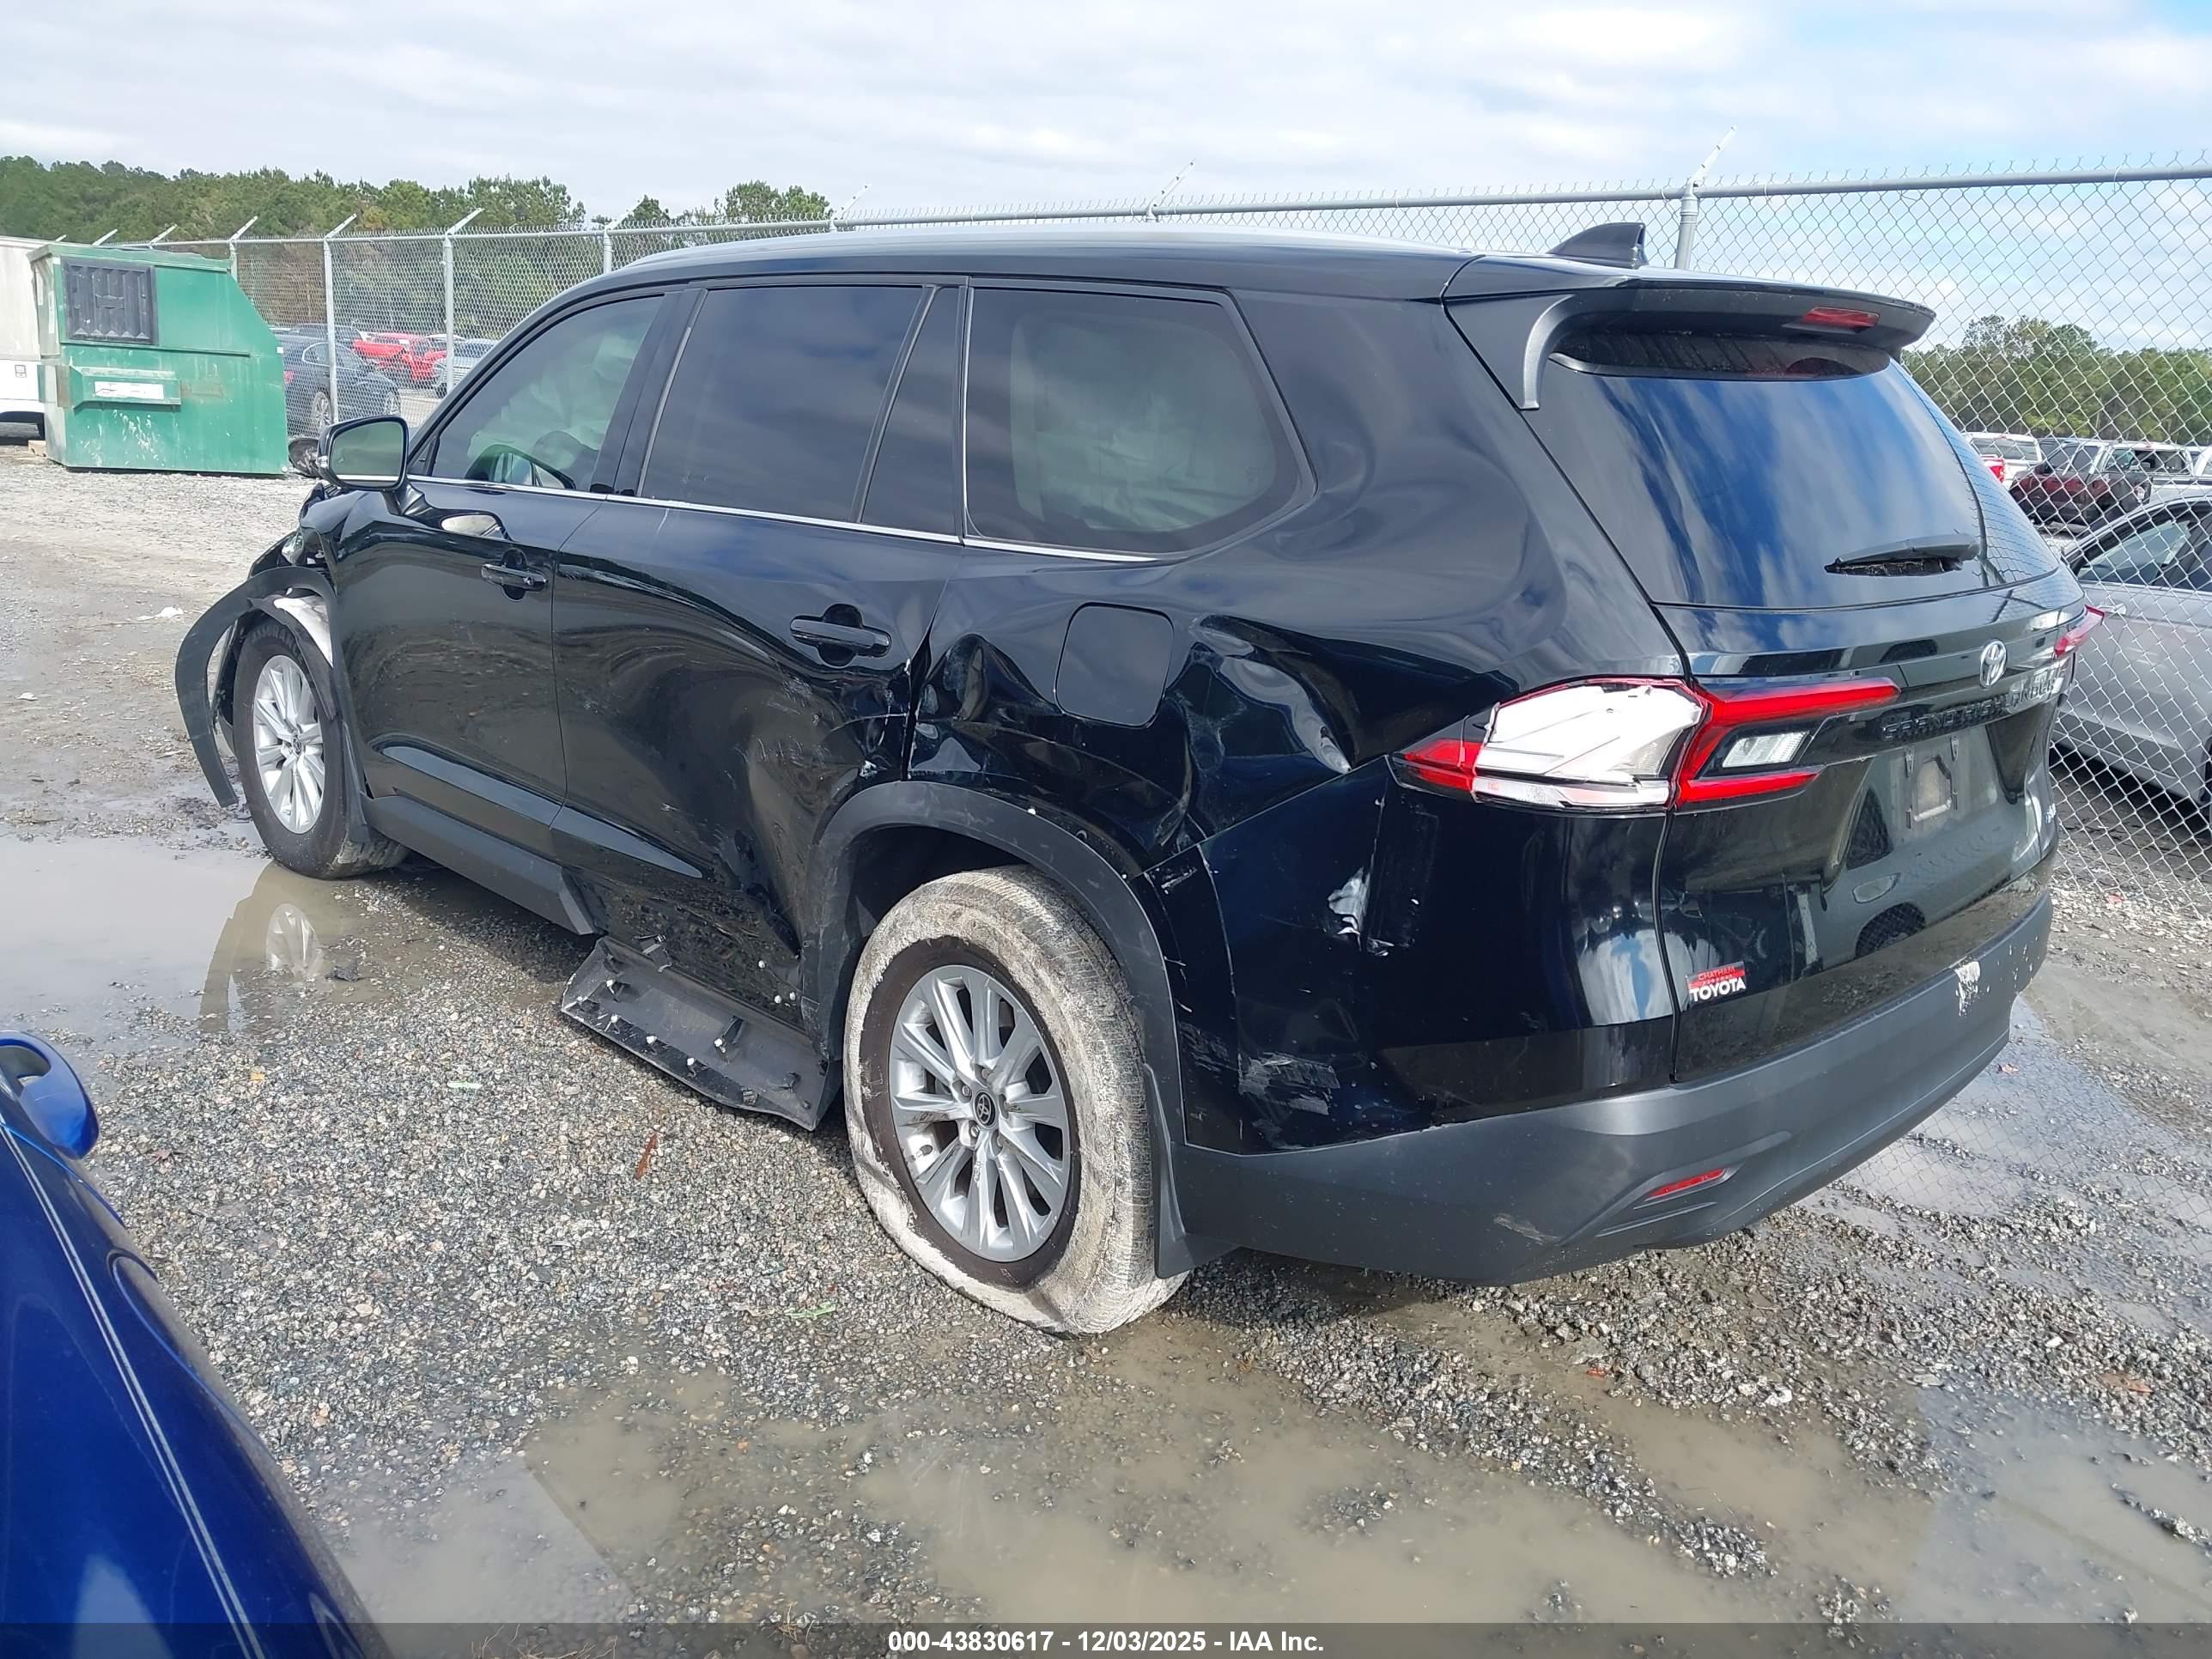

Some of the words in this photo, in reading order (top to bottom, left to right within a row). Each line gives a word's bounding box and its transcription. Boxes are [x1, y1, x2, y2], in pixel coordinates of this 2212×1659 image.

[1883, 709, 1958, 741] GRAND
[1698, 965, 1736, 981] CHATHAM
[1688, 976, 1747, 1002] TOYOTA
